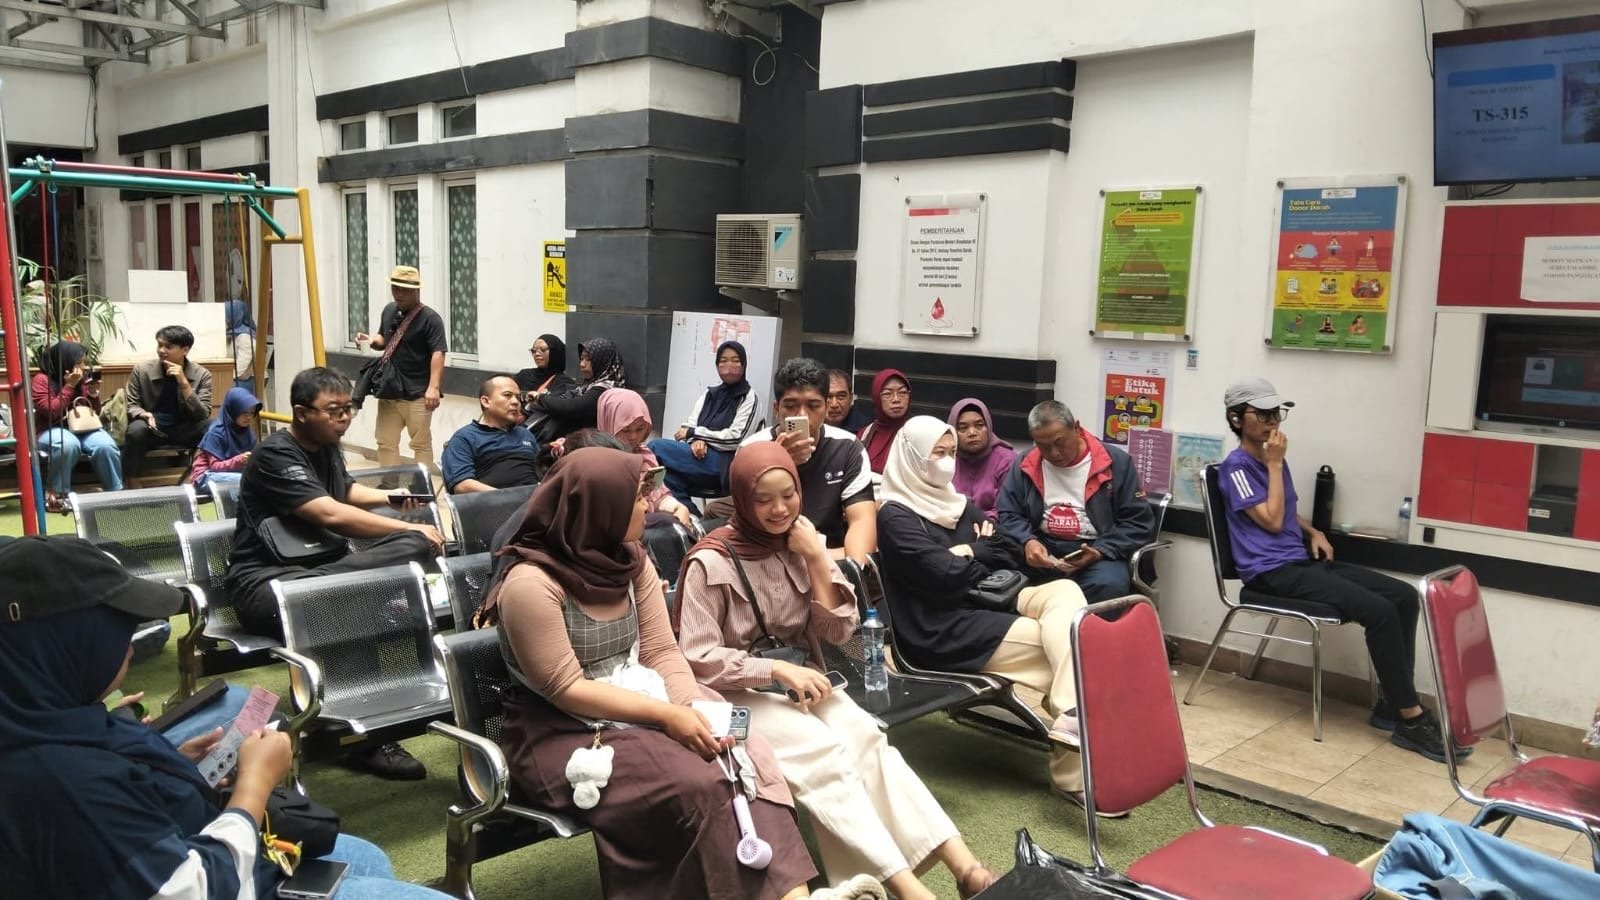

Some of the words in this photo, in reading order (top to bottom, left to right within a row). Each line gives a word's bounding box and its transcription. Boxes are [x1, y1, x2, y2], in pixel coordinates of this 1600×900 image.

[1472, 106, 1529, 122] TS-315
[1125, 378, 1157, 388] Etika
[1124, 384, 1160, 395] Batuk
